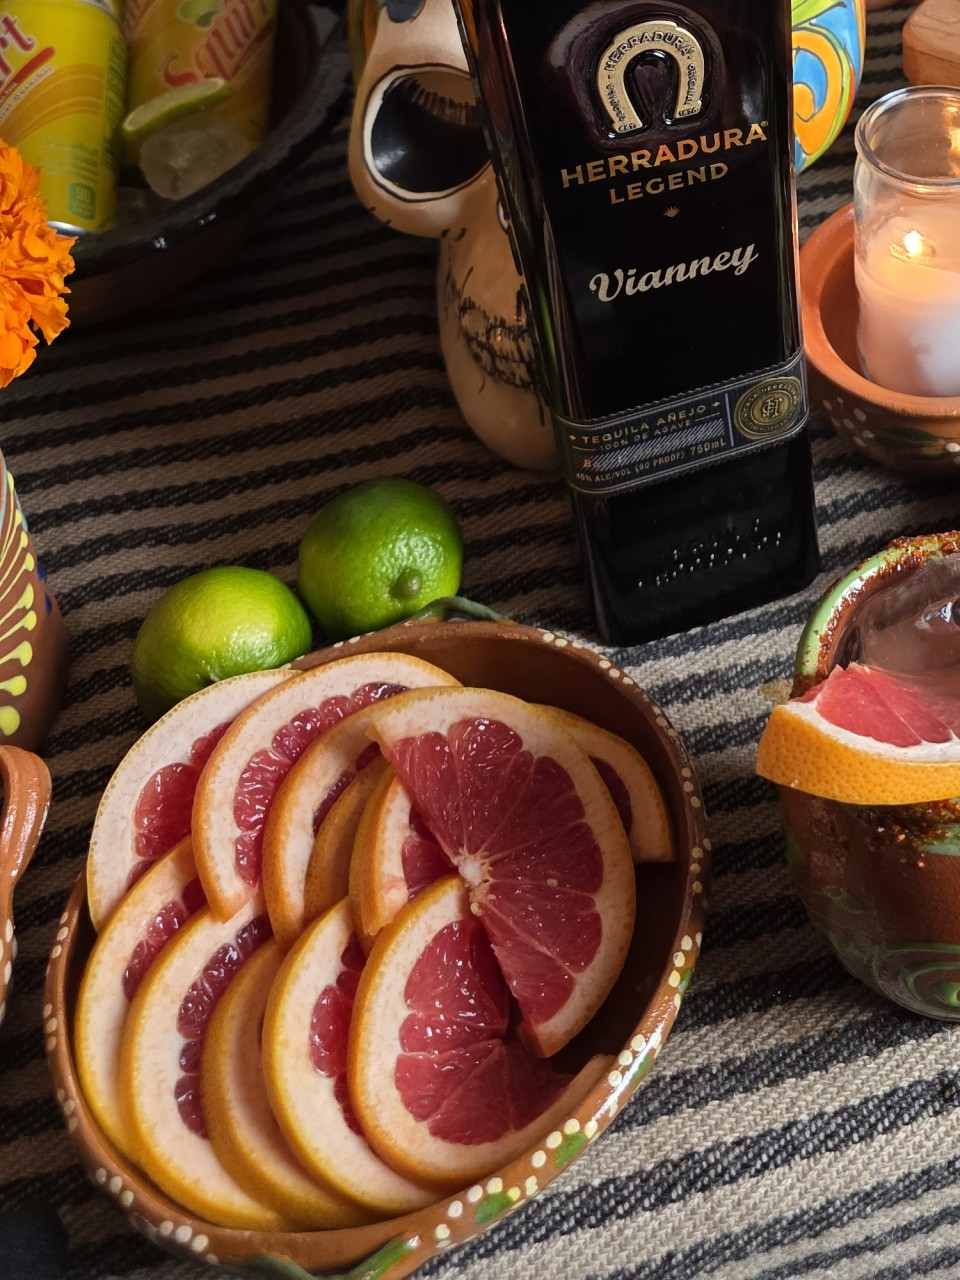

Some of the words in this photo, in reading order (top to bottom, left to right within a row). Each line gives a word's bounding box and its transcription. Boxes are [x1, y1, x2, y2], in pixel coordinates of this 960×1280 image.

[604, 31, 691, 72] HERRADURA
[560, 122, 768, 189] HERRADURA
[609, 162, 729, 205] LEGEND
[588, 243, 760, 303] Vianney
[581, 423, 650, 445] TEQUILA
[656, 404, 706, 426] AÑEJO
[600, 439, 629, 452] 100%
[634, 431, 649, 442] DE
[654, 420, 692, 435] AGAVE
[594, 463, 632, 482] ALC/VOL
